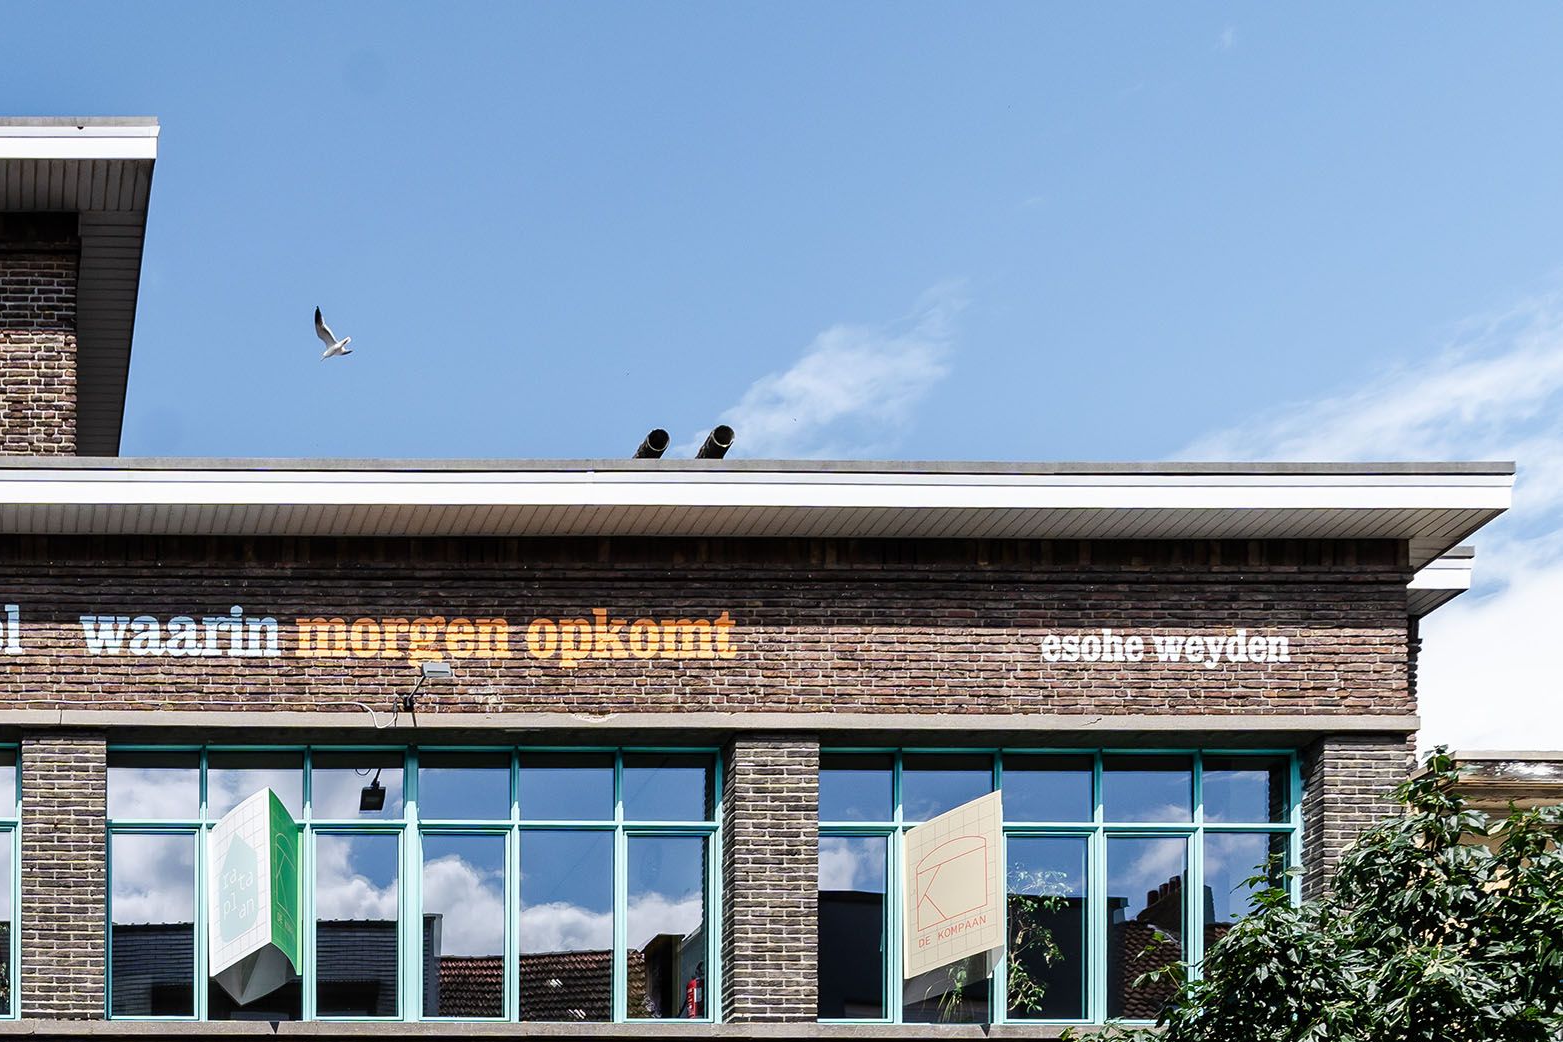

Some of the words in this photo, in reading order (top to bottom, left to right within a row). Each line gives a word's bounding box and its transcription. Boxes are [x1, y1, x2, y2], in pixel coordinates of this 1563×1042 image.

[79, 604, 282, 658] waarin
[295, 611, 510, 668] morgen
[525, 608, 739, 669] opkomt
[1041, 628, 1145, 663] esohe
[1153, 628, 1291, 669] weyden
[918, 936, 931, 949] DE
[938, 914, 987, 941] KOMPAAN
